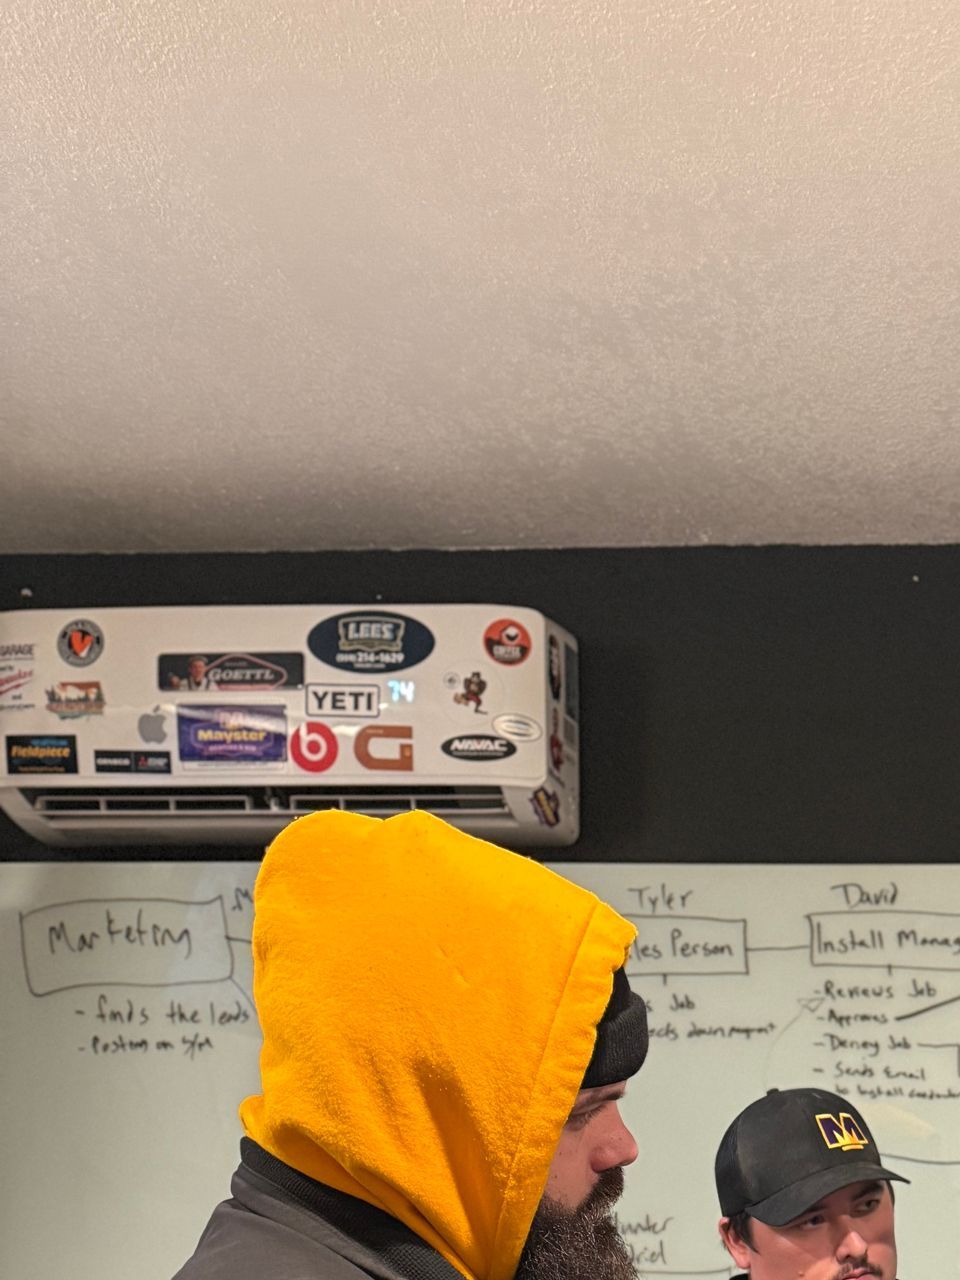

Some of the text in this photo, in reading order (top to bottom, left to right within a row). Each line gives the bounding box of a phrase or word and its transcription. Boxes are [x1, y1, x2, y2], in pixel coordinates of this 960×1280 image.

[312, 691, 373, 711] YETI
[387, 679, 416, 703] 74
[196, 729, 266, 744] Mayster
[449, 739, 508, 751] NAVAC
[10, 745, 71, 759] Fieldpiece
[626, 882, 694, 913] Tyler
[829, 881, 898, 909] David
[48, 908, 193, 960] Marketing
[670, 927, 734, 958] Person
[816, 921, 884, 954] Install
[907, 978, 937, 998] Job
[166, 1000, 201, 1025] the
